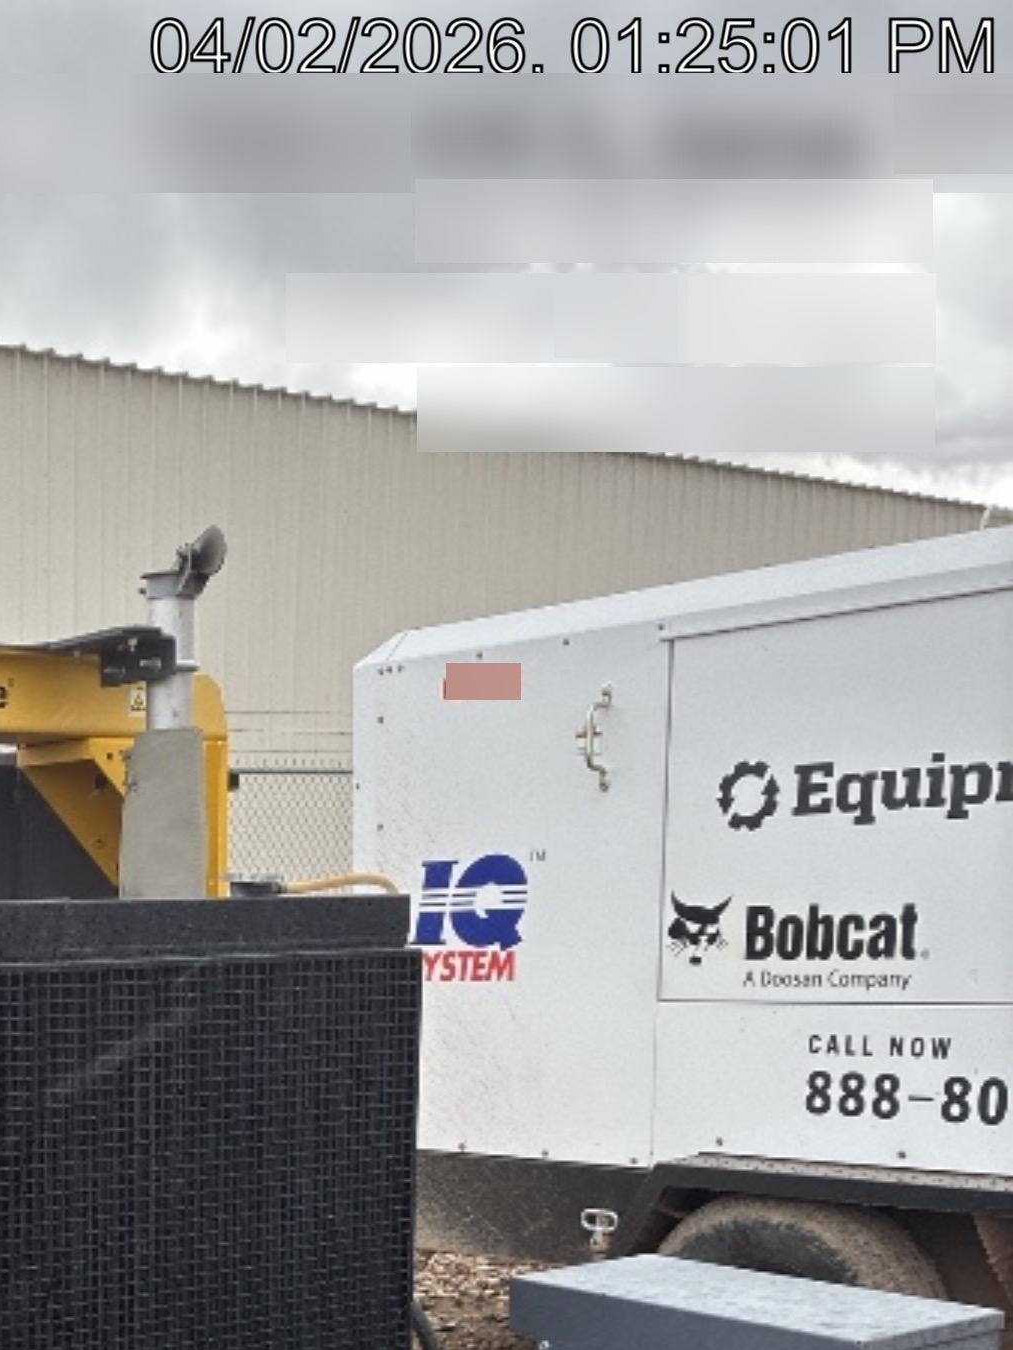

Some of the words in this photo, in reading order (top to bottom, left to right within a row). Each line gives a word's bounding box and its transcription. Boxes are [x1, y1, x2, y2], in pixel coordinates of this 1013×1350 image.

[409, 853, 528, 951] IQ
[744, 902, 918, 961] Bobcat
[421, 950, 517, 982] YSTEM
[742, 970, 757, 988] A
[760, 970, 823, 988] Doosan
[827, 969, 913, 991] Company
[807, 1034, 874, 1057] CALL
[889, 1036, 952, 1060] NOW
[805, 1070, 1009, 1126] 888-80
